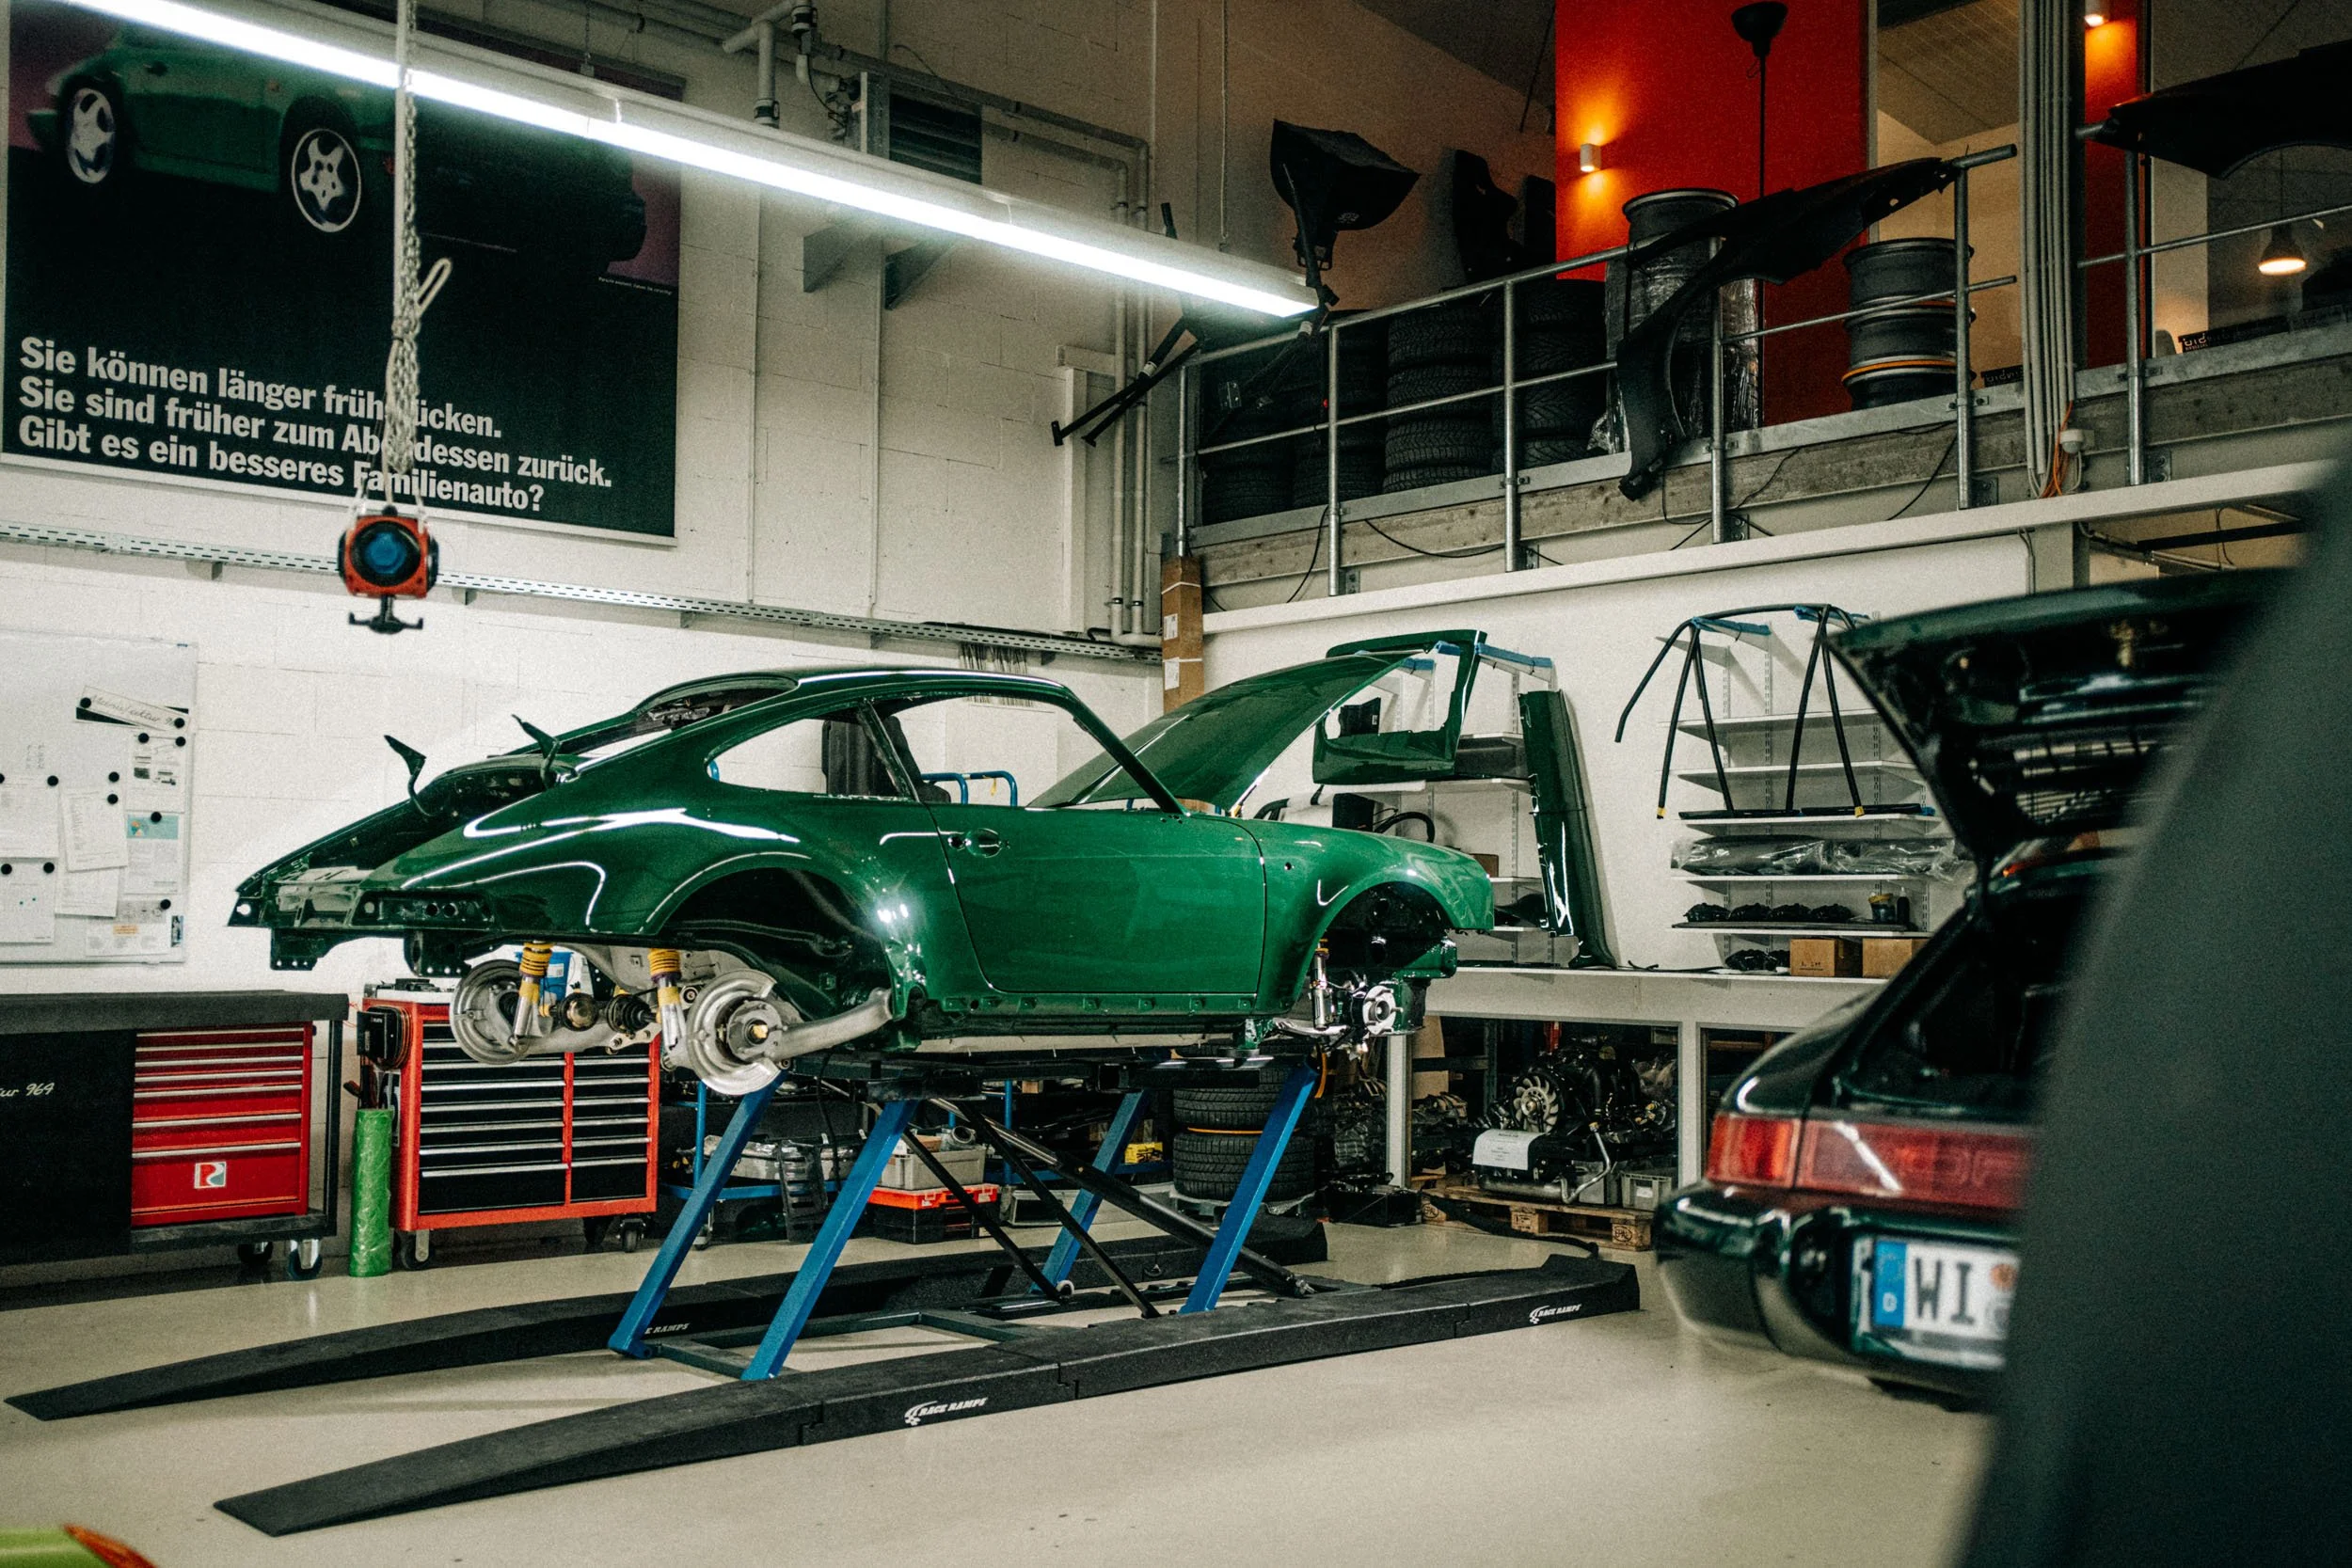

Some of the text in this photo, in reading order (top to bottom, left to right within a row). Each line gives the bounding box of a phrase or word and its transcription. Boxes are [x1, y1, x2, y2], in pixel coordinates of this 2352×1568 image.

[19, 336, 76, 374] Sie
[87, 346, 208, 395] können
[218, 367, 316, 411] länger
[19, 375, 612, 487] Sie sind früher zum Abdessen zurück.
[19, 414, 545, 512] Gibt es ein besseres Familienauto?
[25, 1082, 56, 1097] 964
[1557, 1304, 1581, 1314] RAMPS
[653, 1323, 691, 1333] RAMPS
[918, 1397, 988, 1417] RACE RAMPS
